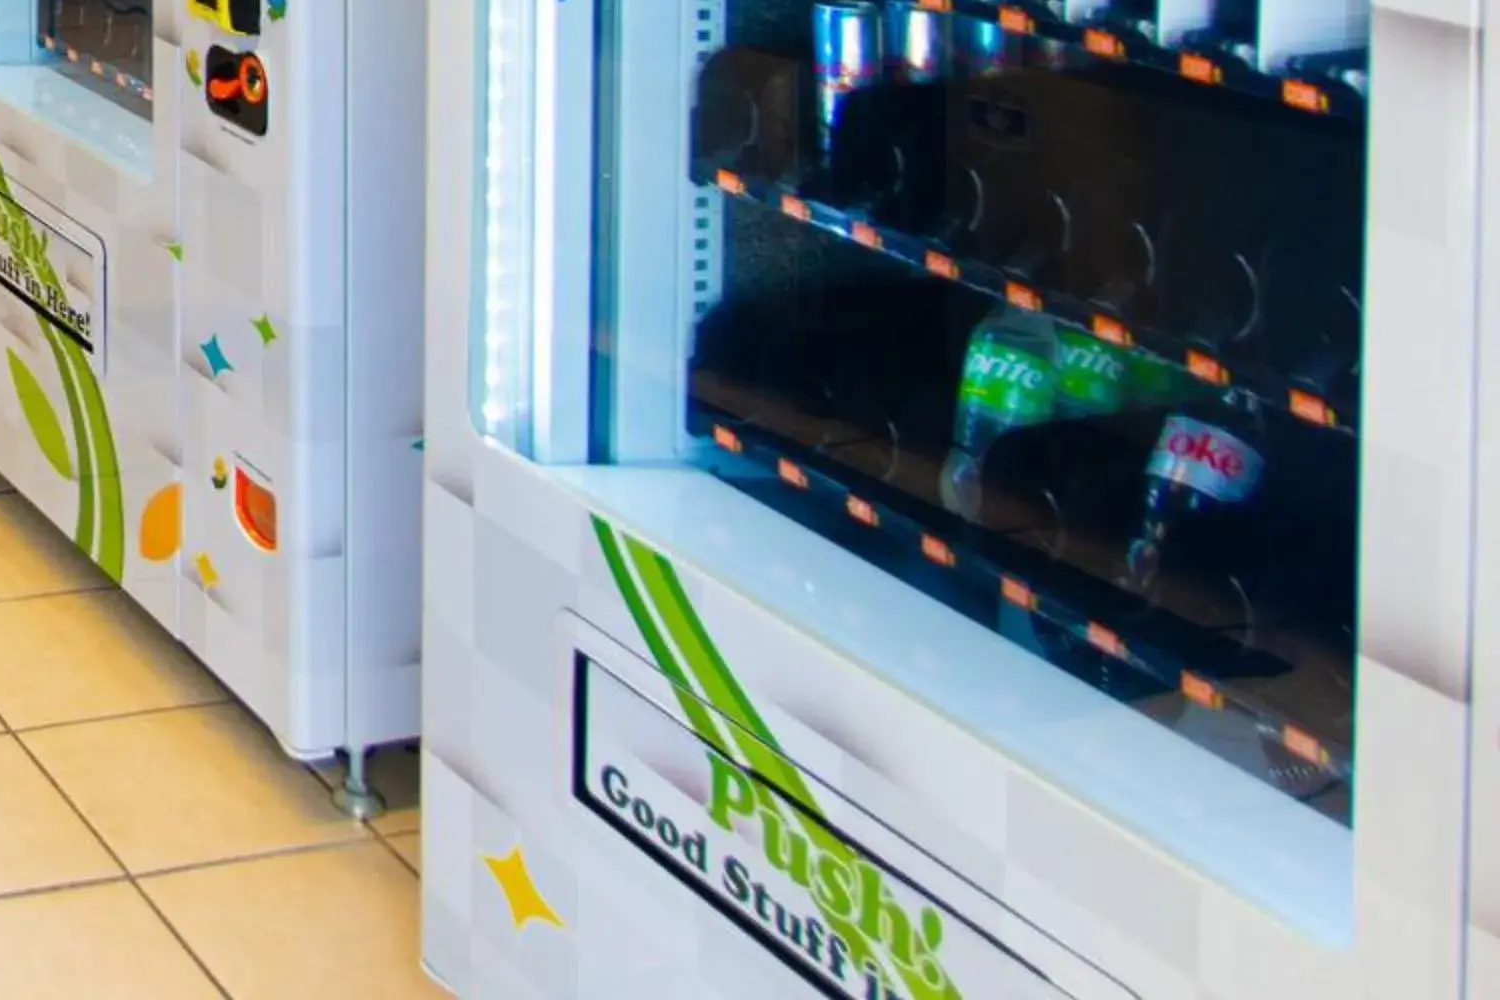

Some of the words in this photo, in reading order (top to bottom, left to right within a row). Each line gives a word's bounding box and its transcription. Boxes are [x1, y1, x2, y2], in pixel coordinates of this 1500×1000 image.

[24, 271, 42, 299] in
[46, 282, 92, 337] Here!
[967, 346, 1043, 390] prite
[1167, 430, 1245, 478] oke
[601, 763, 708, 874] Good
[721, 854, 850, 980] Stuff
[705, 748, 946, 992] Push!
